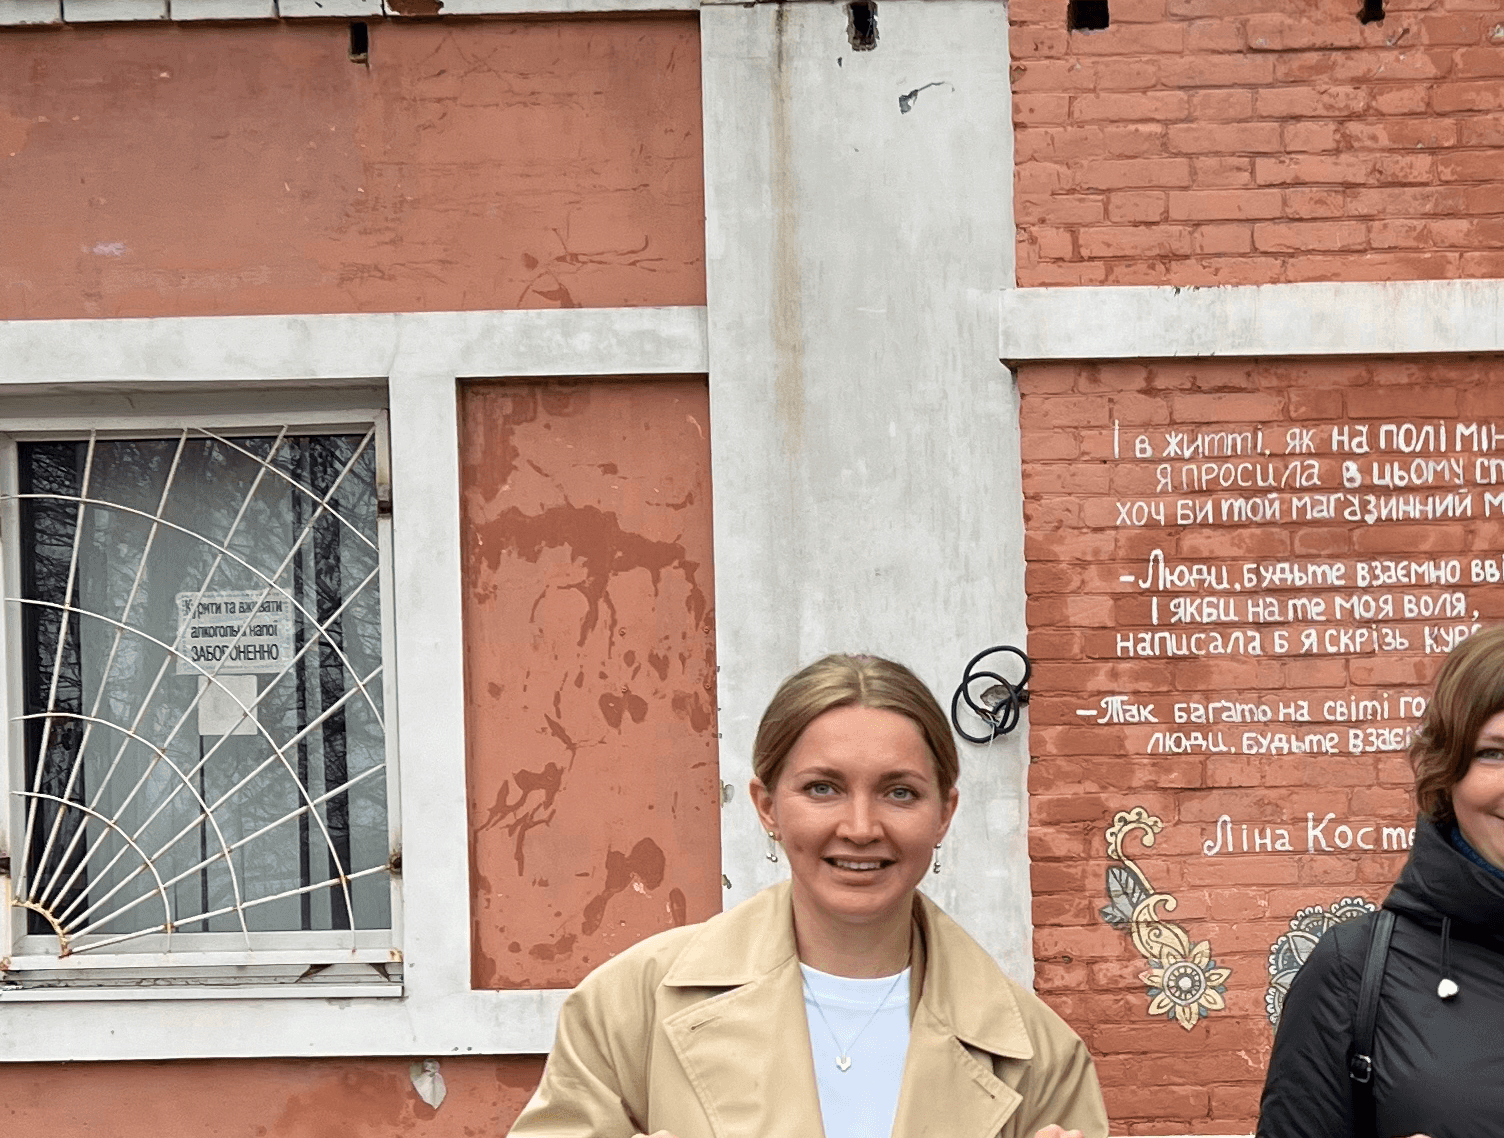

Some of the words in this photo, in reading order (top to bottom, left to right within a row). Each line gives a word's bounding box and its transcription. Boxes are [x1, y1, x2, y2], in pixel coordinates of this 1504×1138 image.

[1285, 428, 1317, 455] як
[224, 601, 236, 614] та
[239, 600, 283, 614] вжвати
[191, 625, 246, 639] алкоголь
[1202, 814, 1294, 857] Ліна
